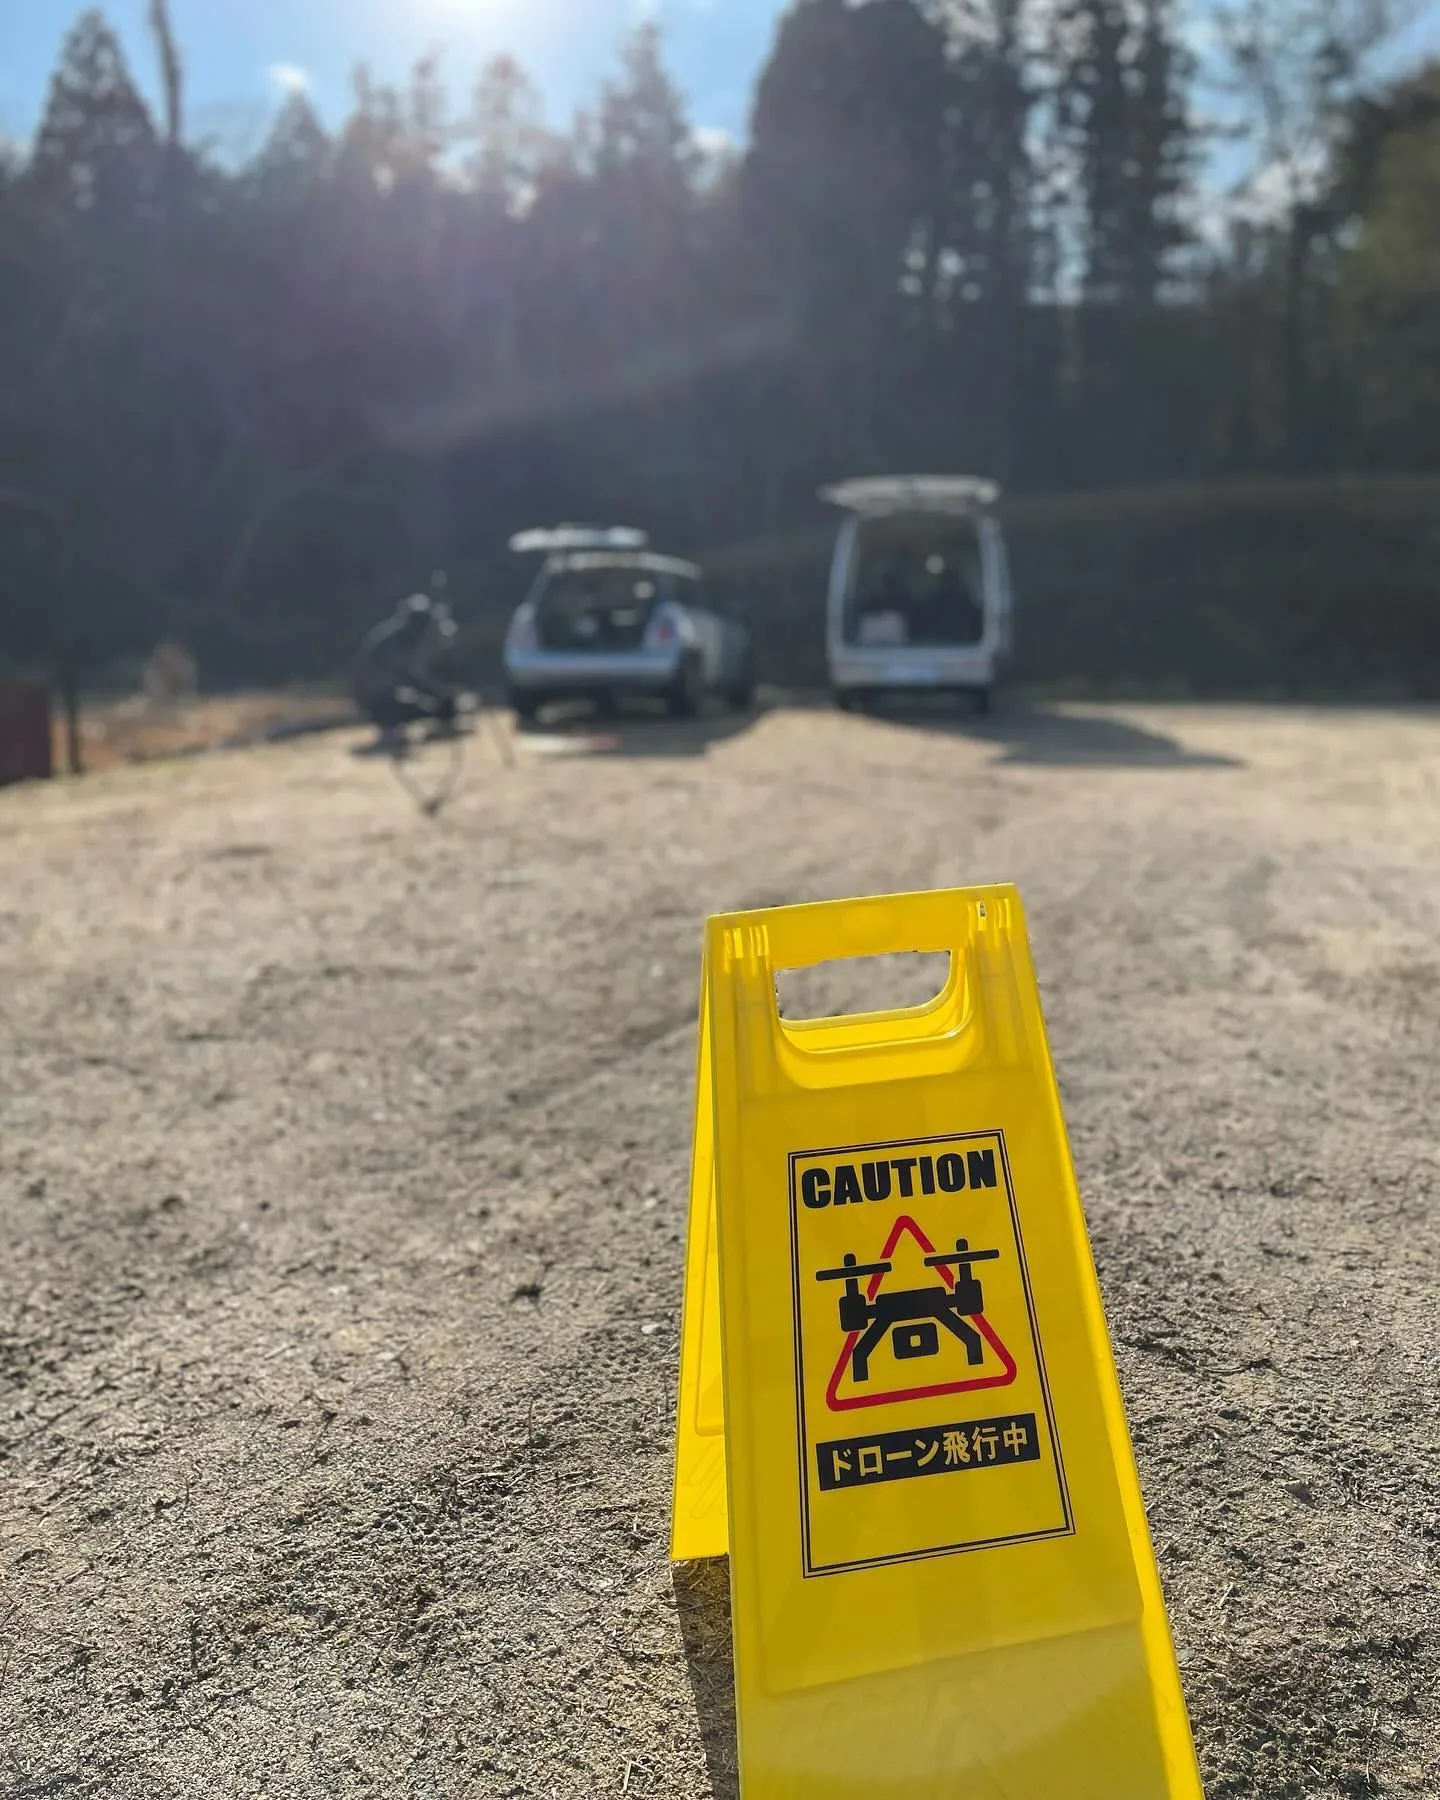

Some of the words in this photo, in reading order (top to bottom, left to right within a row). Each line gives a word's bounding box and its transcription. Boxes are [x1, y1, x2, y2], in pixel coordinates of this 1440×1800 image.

[801, 1149, 997, 1209] CAUTION
[832, 1422, 1028, 1482] ドローン飛行中
